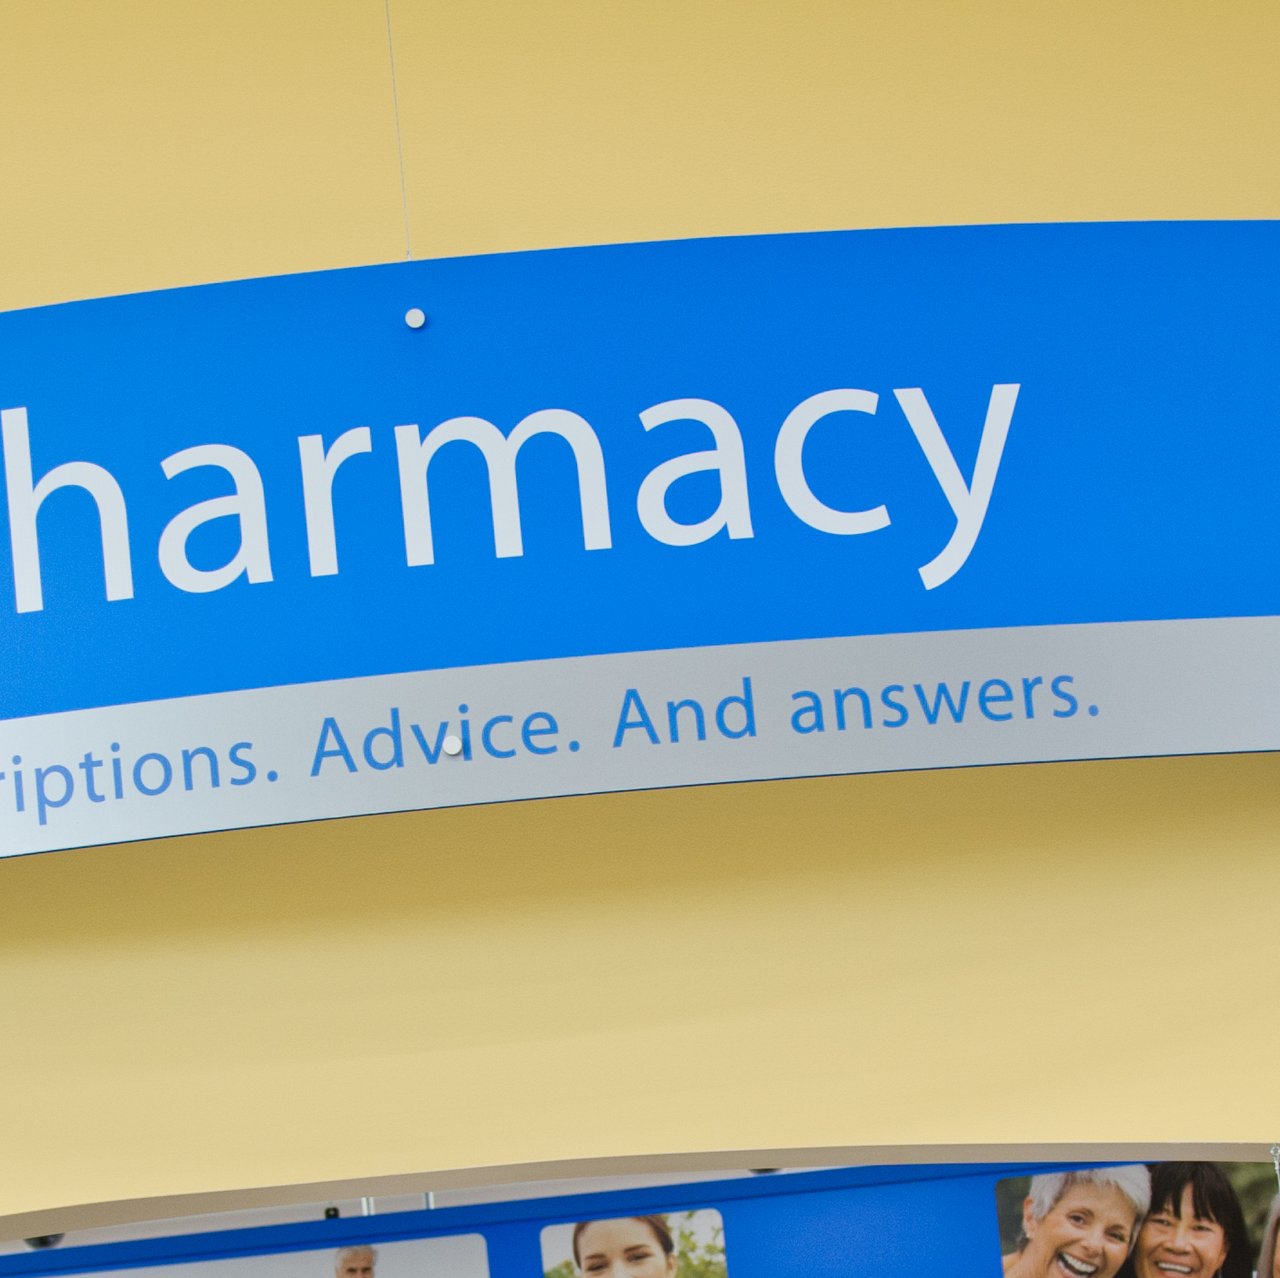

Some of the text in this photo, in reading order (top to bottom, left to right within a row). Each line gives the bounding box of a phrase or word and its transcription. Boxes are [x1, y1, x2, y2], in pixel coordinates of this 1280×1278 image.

[310, 705, 581, 777] Advice.
[612, 676, 758, 748] And
[790, 673, 1100, 735] answers.
